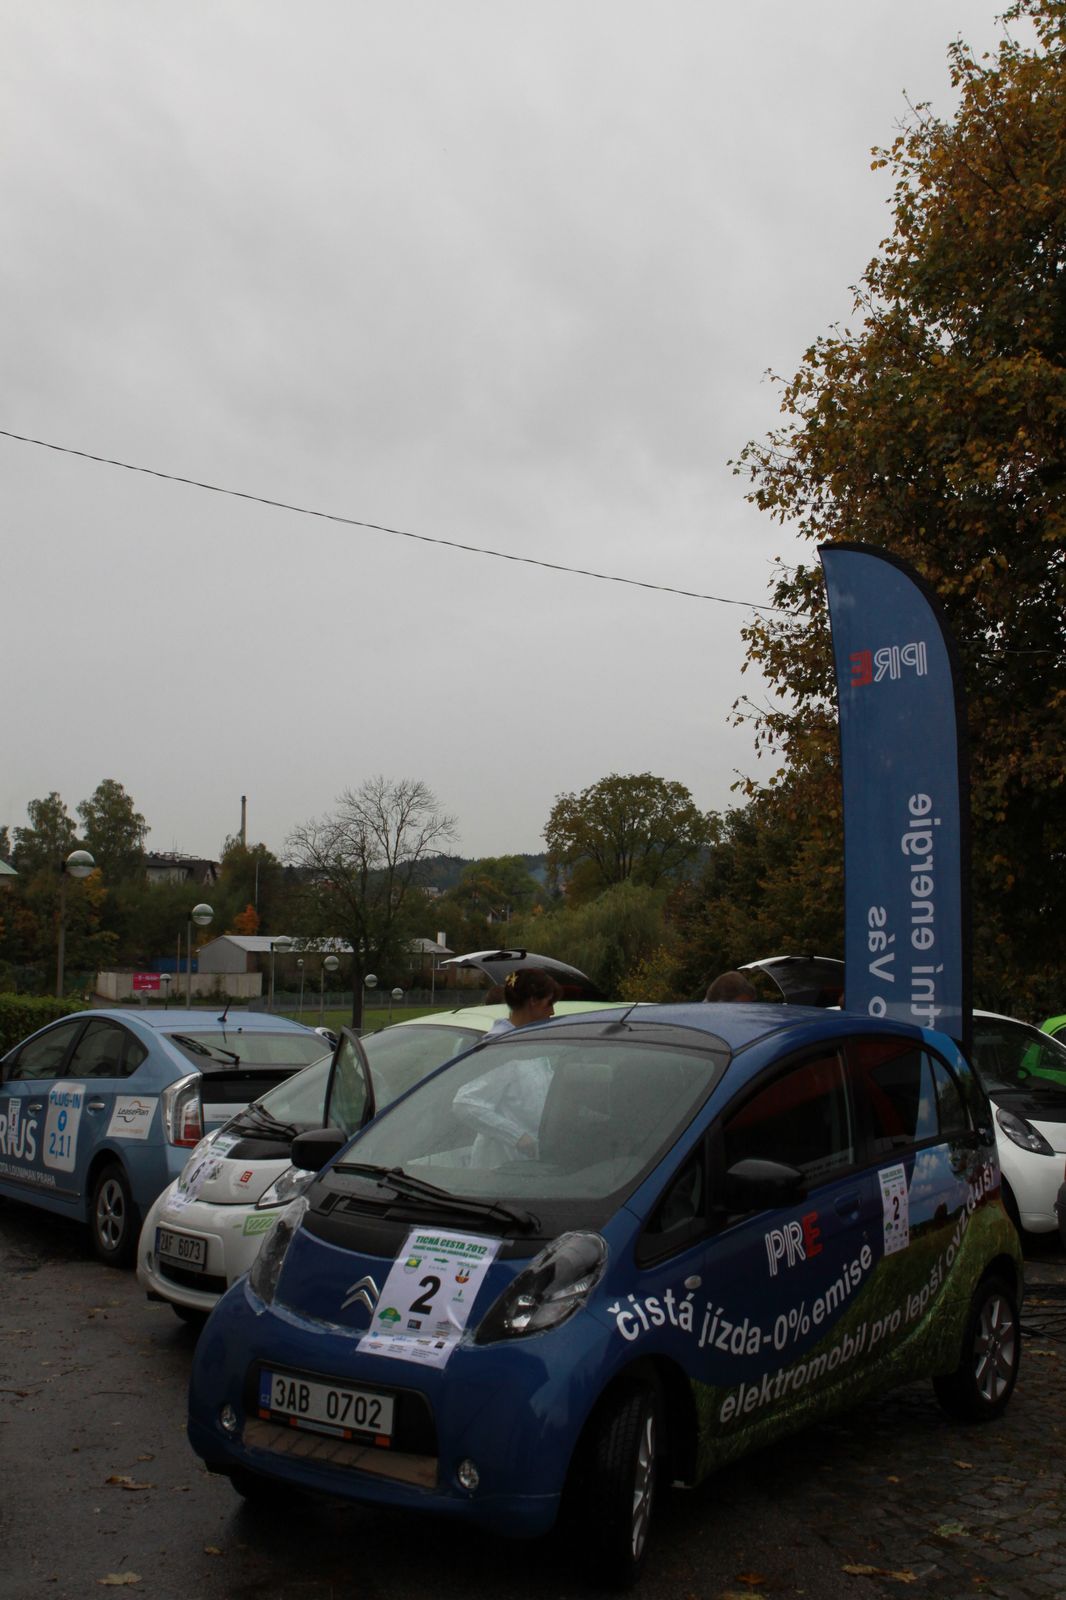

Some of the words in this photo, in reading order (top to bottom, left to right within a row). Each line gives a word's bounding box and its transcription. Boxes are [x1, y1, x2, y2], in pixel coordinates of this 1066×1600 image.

[49, 1091, 81, 1109] PLUG-IN
[117, 1107, 149, 1116] LeasePlan
[892, 1196, 900, 1221] 2
[160, 1232, 174, 1252] 2AF
[178, 1238, 201, 1260] 6073
[415, 1235, 440, 1247] TICHÁ
[439, 1238, 467, 1250] CESTA
[466, 1243, 488, 1254] 2012
[765, 1211, 824, 1277] PRE
[408, 1275, 441, 1316] 2
[606, 1288, 694, 1341] čistá
[812, 1244, 873, 1326] emise
[719, 1322, 869, 1423] elektromobil
[867, 1306, 902, 1351] pro
[904, 1254, 943, 1323] lepší
[274, 1379, 310, 1413] 3AB
[326, 1391, 382, 1429] 0702
